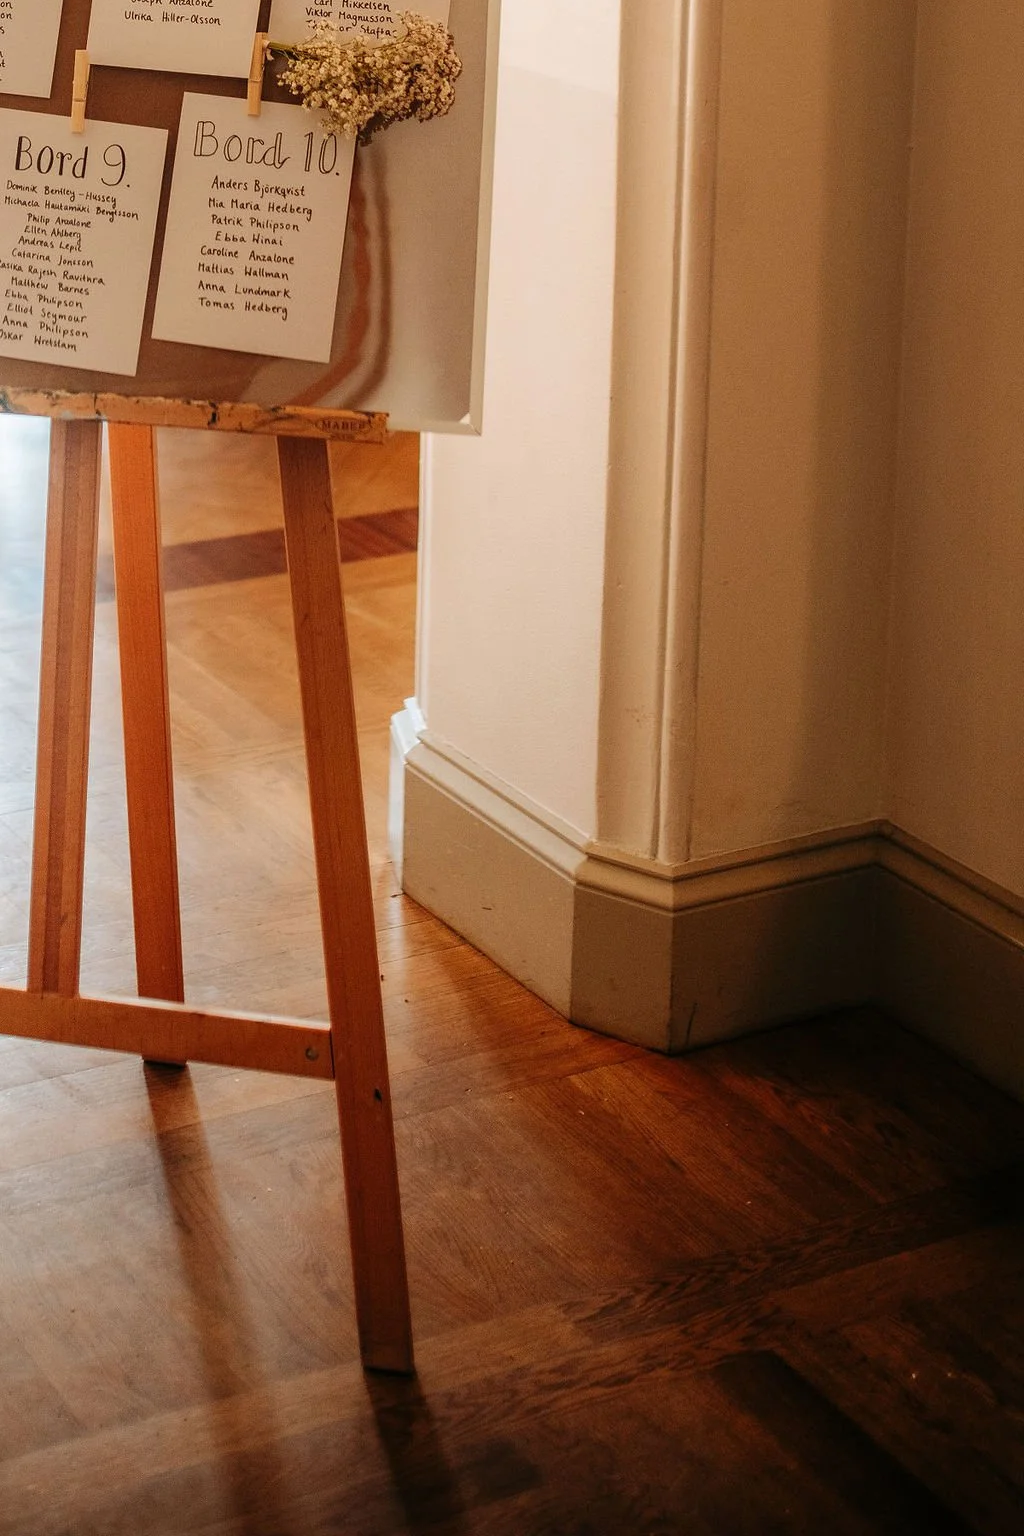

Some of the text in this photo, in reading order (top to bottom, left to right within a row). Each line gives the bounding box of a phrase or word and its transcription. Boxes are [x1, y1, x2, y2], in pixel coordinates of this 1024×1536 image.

[124, 10, 154, 22] Ulrika
[305, 7, 333, 18] Viktor
[338, 11, 394, 27] Magnusson
[193, 120, 340, 176] Bord 10.
[15, 135, 130, 188] Bord 9.
[211, 175, 248, 191] Anders
[208, 197, 312, 223] Mia Maria Hedberg
[211, 214, 300, 234] Patrik Philipson
[24, 225, 82, 245] Ellen Ahlberg
[200, 245, 294, 265] Caroline Anzalone
[198, 262, 289, 281] Mattias Wallman
[58, 282, 90, 296] Barnes
[198, 280, 292, 299] Anna Lundmark
[4, 289, 83, 310] Ebba Philipson
[198, 297, 288, 322] Tomas Hedberg
[2, 315, 89, 338] Anna Philipson
[41, 308, 87, 326] Seymour
